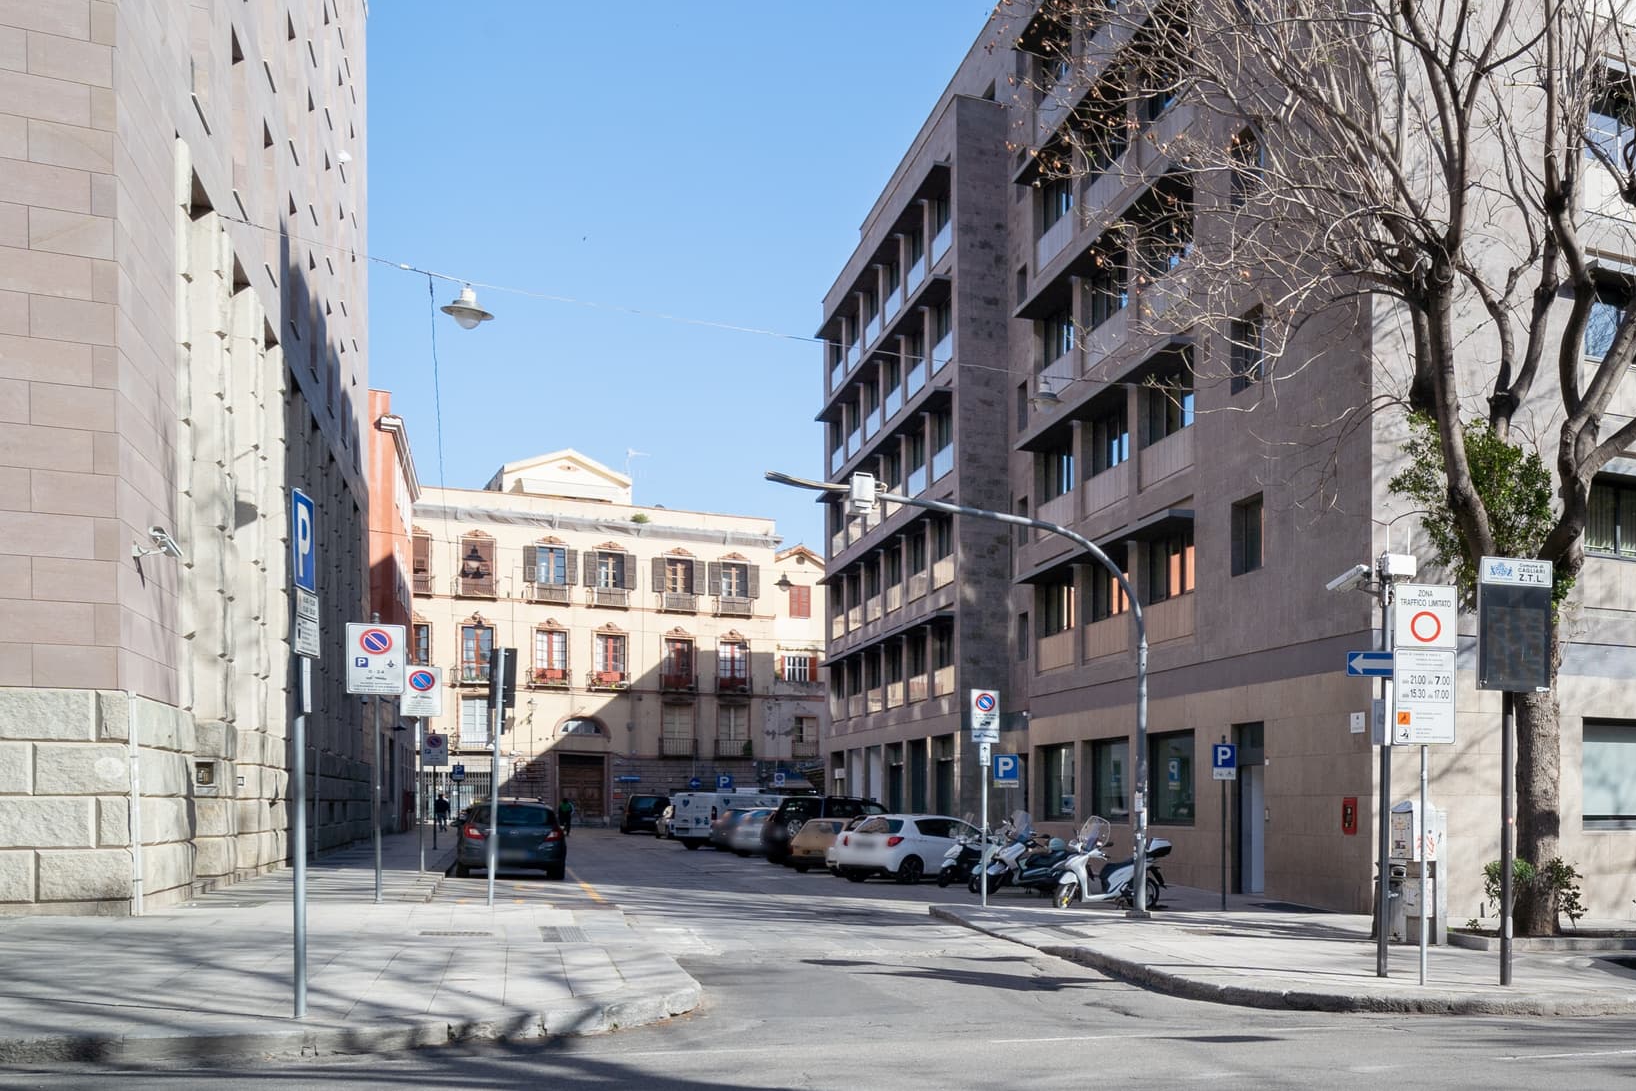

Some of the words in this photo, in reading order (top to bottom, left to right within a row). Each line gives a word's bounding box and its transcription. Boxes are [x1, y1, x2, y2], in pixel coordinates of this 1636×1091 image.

[297, 501, 311, 578] P
[1519, 573, 1544, 583] Z.T.L.
[1400, 598, 1427, 607] TRAFFICO
[1428, 599, 1452, 608] LIMITATO
[357, 658, 366, 666] P
[1410, 675, 1426, 685] 21.00
[1435, 676, 1451, 686] 7.00
[1410, 689, 1426, 699] 15.30
[1434, 690, 1450, 700] 17.00
[1217, 746, 1231, 766] P
[998, 757, 1014, 778] P
[719, 776, 730, 787] P
